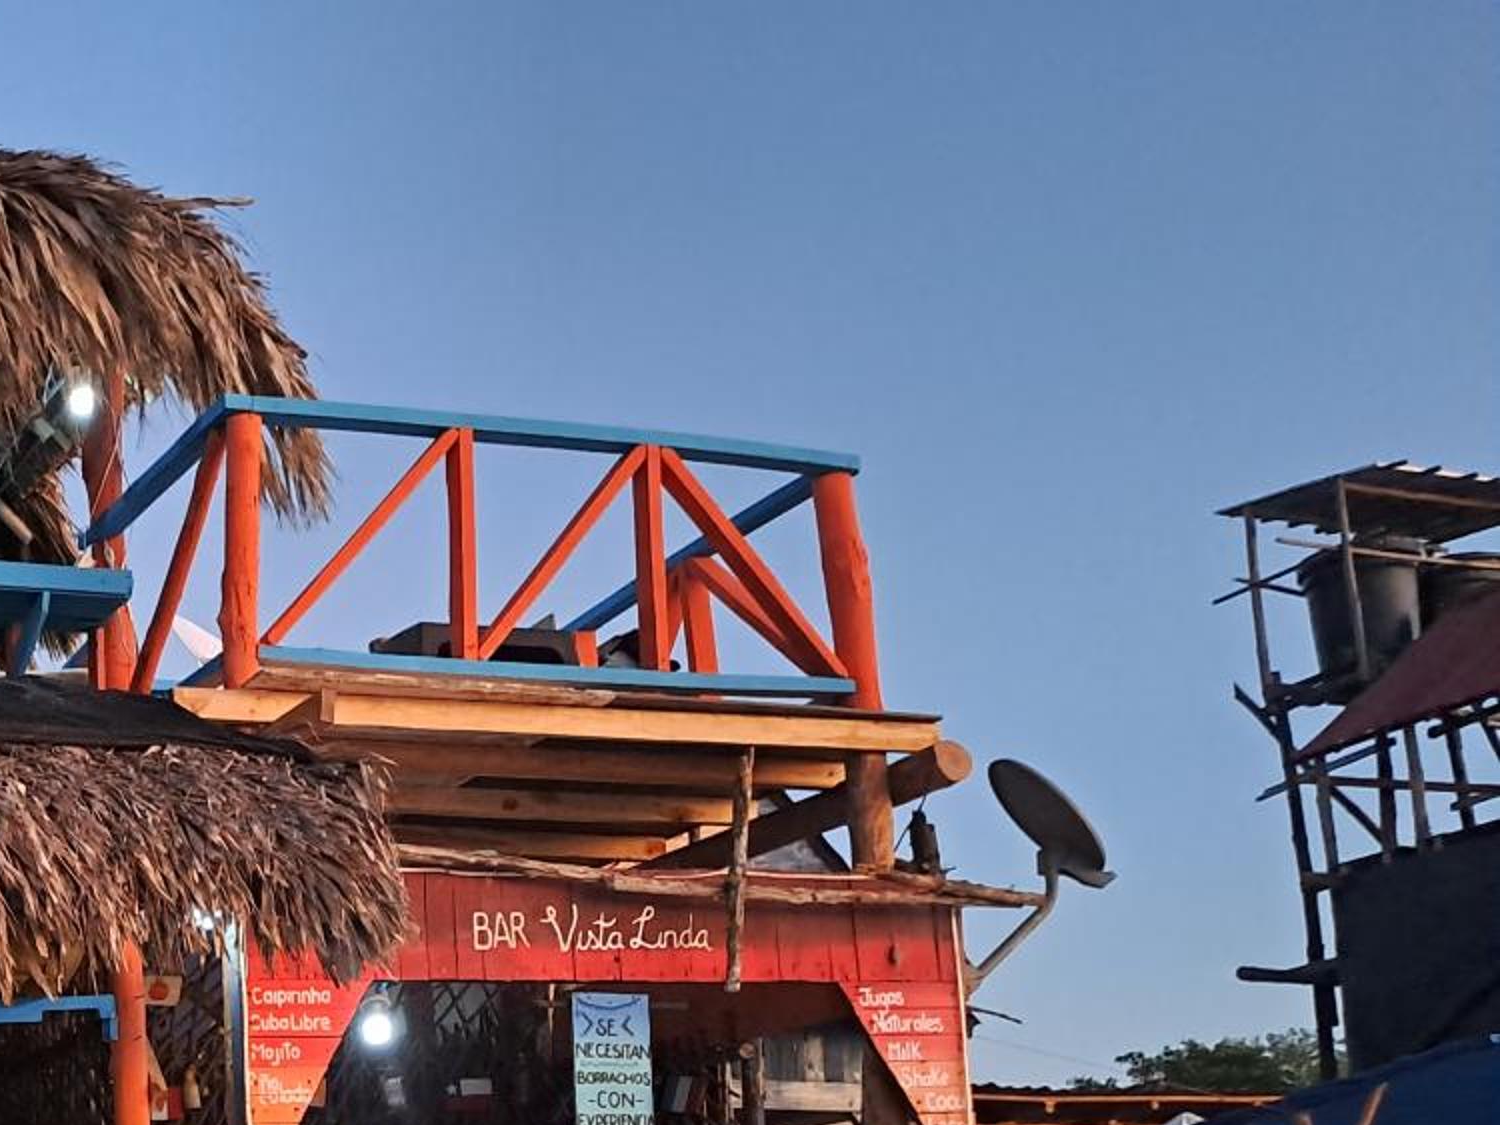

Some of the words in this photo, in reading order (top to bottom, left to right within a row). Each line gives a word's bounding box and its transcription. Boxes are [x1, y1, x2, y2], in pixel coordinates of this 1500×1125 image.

[473, 912, 532, 951] BAR
[540, 903, 625, 953] Vista
[629, 905, 714, 952] Linda
[595, 1018, 617, 1037] SE
[575, 1043, 650, 1060] NECESITAN
[577, 1071, 651, 1086] BORRACHOS
[597, 1091, 635, 1109] CON
